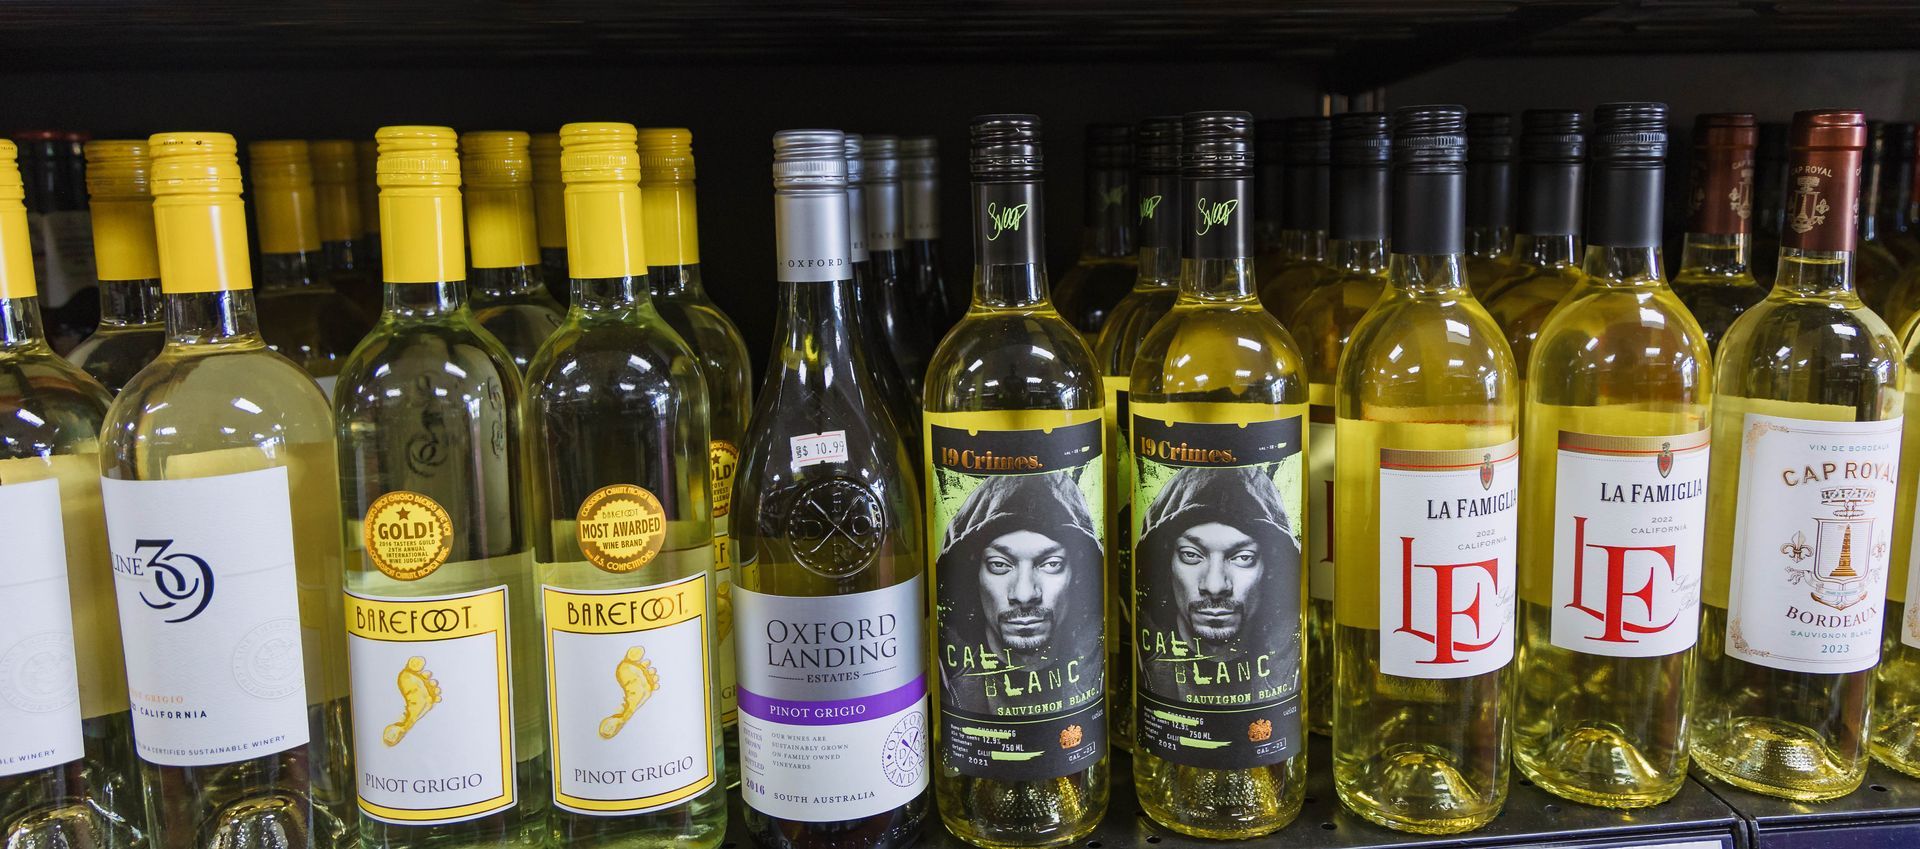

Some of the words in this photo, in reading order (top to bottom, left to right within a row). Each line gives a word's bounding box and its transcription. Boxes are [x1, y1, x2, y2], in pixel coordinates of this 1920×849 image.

[1805, 166, 1832, 178] ROYAL
[788, 259, 843, 268] OXFORD
[816, 440, 845, 456] 10.99
[1140, 436, 1156, 457] 19
[941, 446, 959, 467] 19
[1782, 462, 1837, 488] CAP
[1844, 461, 1895, 485] ROYAL
[1601, 482, 1625, 503] LA
[1631, 478, 1703, 503] FAMIGLIA
[1427, 499, 1451, 520] LA
[1651, 516, 1673, 524] 2022
[378, 521, 434, 540] GOLD!
[582, 523, 609, 539] MOST
[613, 517, 661, 538] AWARDED
[1476, 528, 1496, 538] 2022
[1630, 524, 1688, 534] CALIFORNIA
[602, 541, 620, 550] WINE
[621, 538, 643, 548] BRAND
[1457, 536, 1507, 551] CALIFORNIA
[593, 555, 605, 567] U.S.
[111, 551, 144, 577] LINE
[134, 538, 215, 623] 39
[568, 592, 684, 627] BAREFOOT
[1786, 604, 1877, 628] BORDEAUX
[356, 605, 472, 634] BAREFOOT
[766, 613, 897, 645] OXFORD
[1790, 629, 1847, 639] SAUVIGNON
[1851, 629, 1872, 638] BLANC
[1141, 628, 1204, 658] CALI
[1821, 643, 1850, 654] 2023
[767, 637, 897, 669] LANDING
[947, 644, 1015, 670] CALI
[807, 671, 860, 683] ESTATES
[1186, 693, 1251, 705] SAUVIGNON
[1258, 683, 1292, 700] BLANC.
[997, 700, 1063, 716] SAUVIGNON
[1069, 688, 1099, 706] BLANC.
[140, 706, 208, 719] CALIFORNIA
[770, 705, 810, 718] PINOT
[814, 704, 866, 718] GRIGIO
[771, 732, 785, 740] OUR
[982, 736, 1001, 745] 12.9%
[1189, 731, 1202, 739] 750
[1203, 732, 1212, 740] ML
[152, 747, 186, 756] CERTIFIED
[188, 742, 248, 756] SUSTAINABLE
[251, 735, 286, 748] WINERY
[771, 741, 819, 751] SUSTAINABLY
[1001, 743, 1014, 752] 750
[1015, 744, 1025, 752] ML
[1158, 740, 1177, 751] 2021
[19, 748, 56, 762] WINERY
[968, 756, 988, 766] 2021
[575, 768, 627, 785] PINOT
[632, 755, 694, 786] GRIGIO
[772, 760, 811, 770] VINEYARDS
[365, 772, 408, 793] PINOT
[413, 772, 483, 794] GRIGIO
[746, 777, 765, 795] 2016
[774, 792, 808, 804] SOUTH
[813, 791, 876, 804] AUSTRALIA
